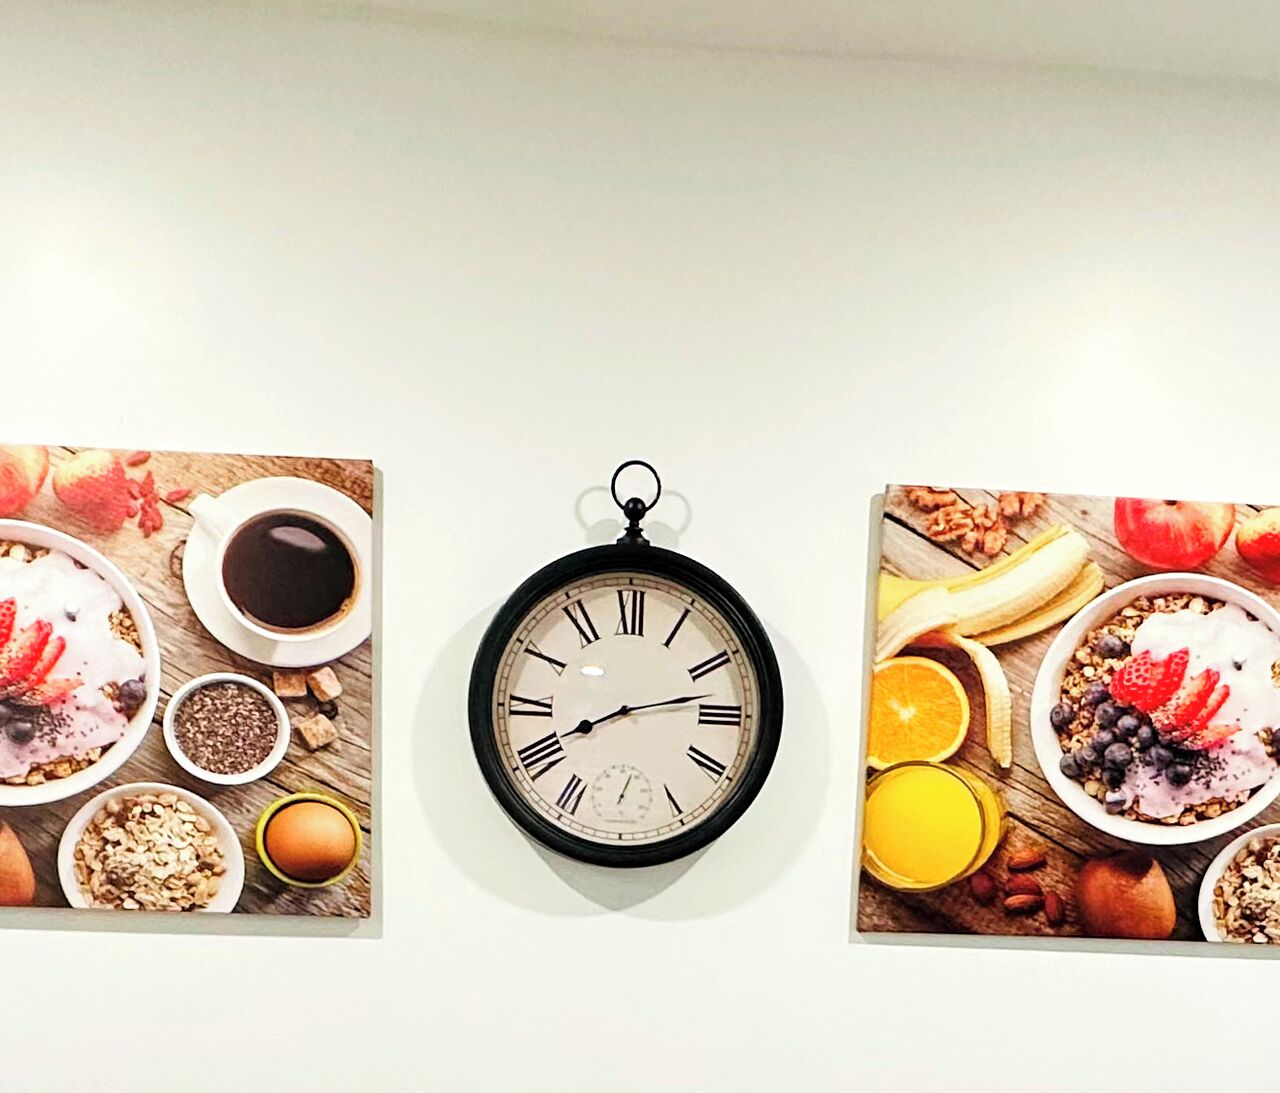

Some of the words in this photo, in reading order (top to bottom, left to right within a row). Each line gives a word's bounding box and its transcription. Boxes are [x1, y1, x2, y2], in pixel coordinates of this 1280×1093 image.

[562, 599, 602, 649] XI
[615, 590, 646, 637] XII
[662, 608, 691, 648] I
[523, 640, 568, 676] X
[687, 650, 731, 682] II
[509, 694, 554, 717] IX
[698, 703, 743, 727] III
[516, 731, 567, 782] VIII
[686, 745, 728, 784] IV
[555, 774, 588, 816] VII
[664, 784, 685, 818] V
